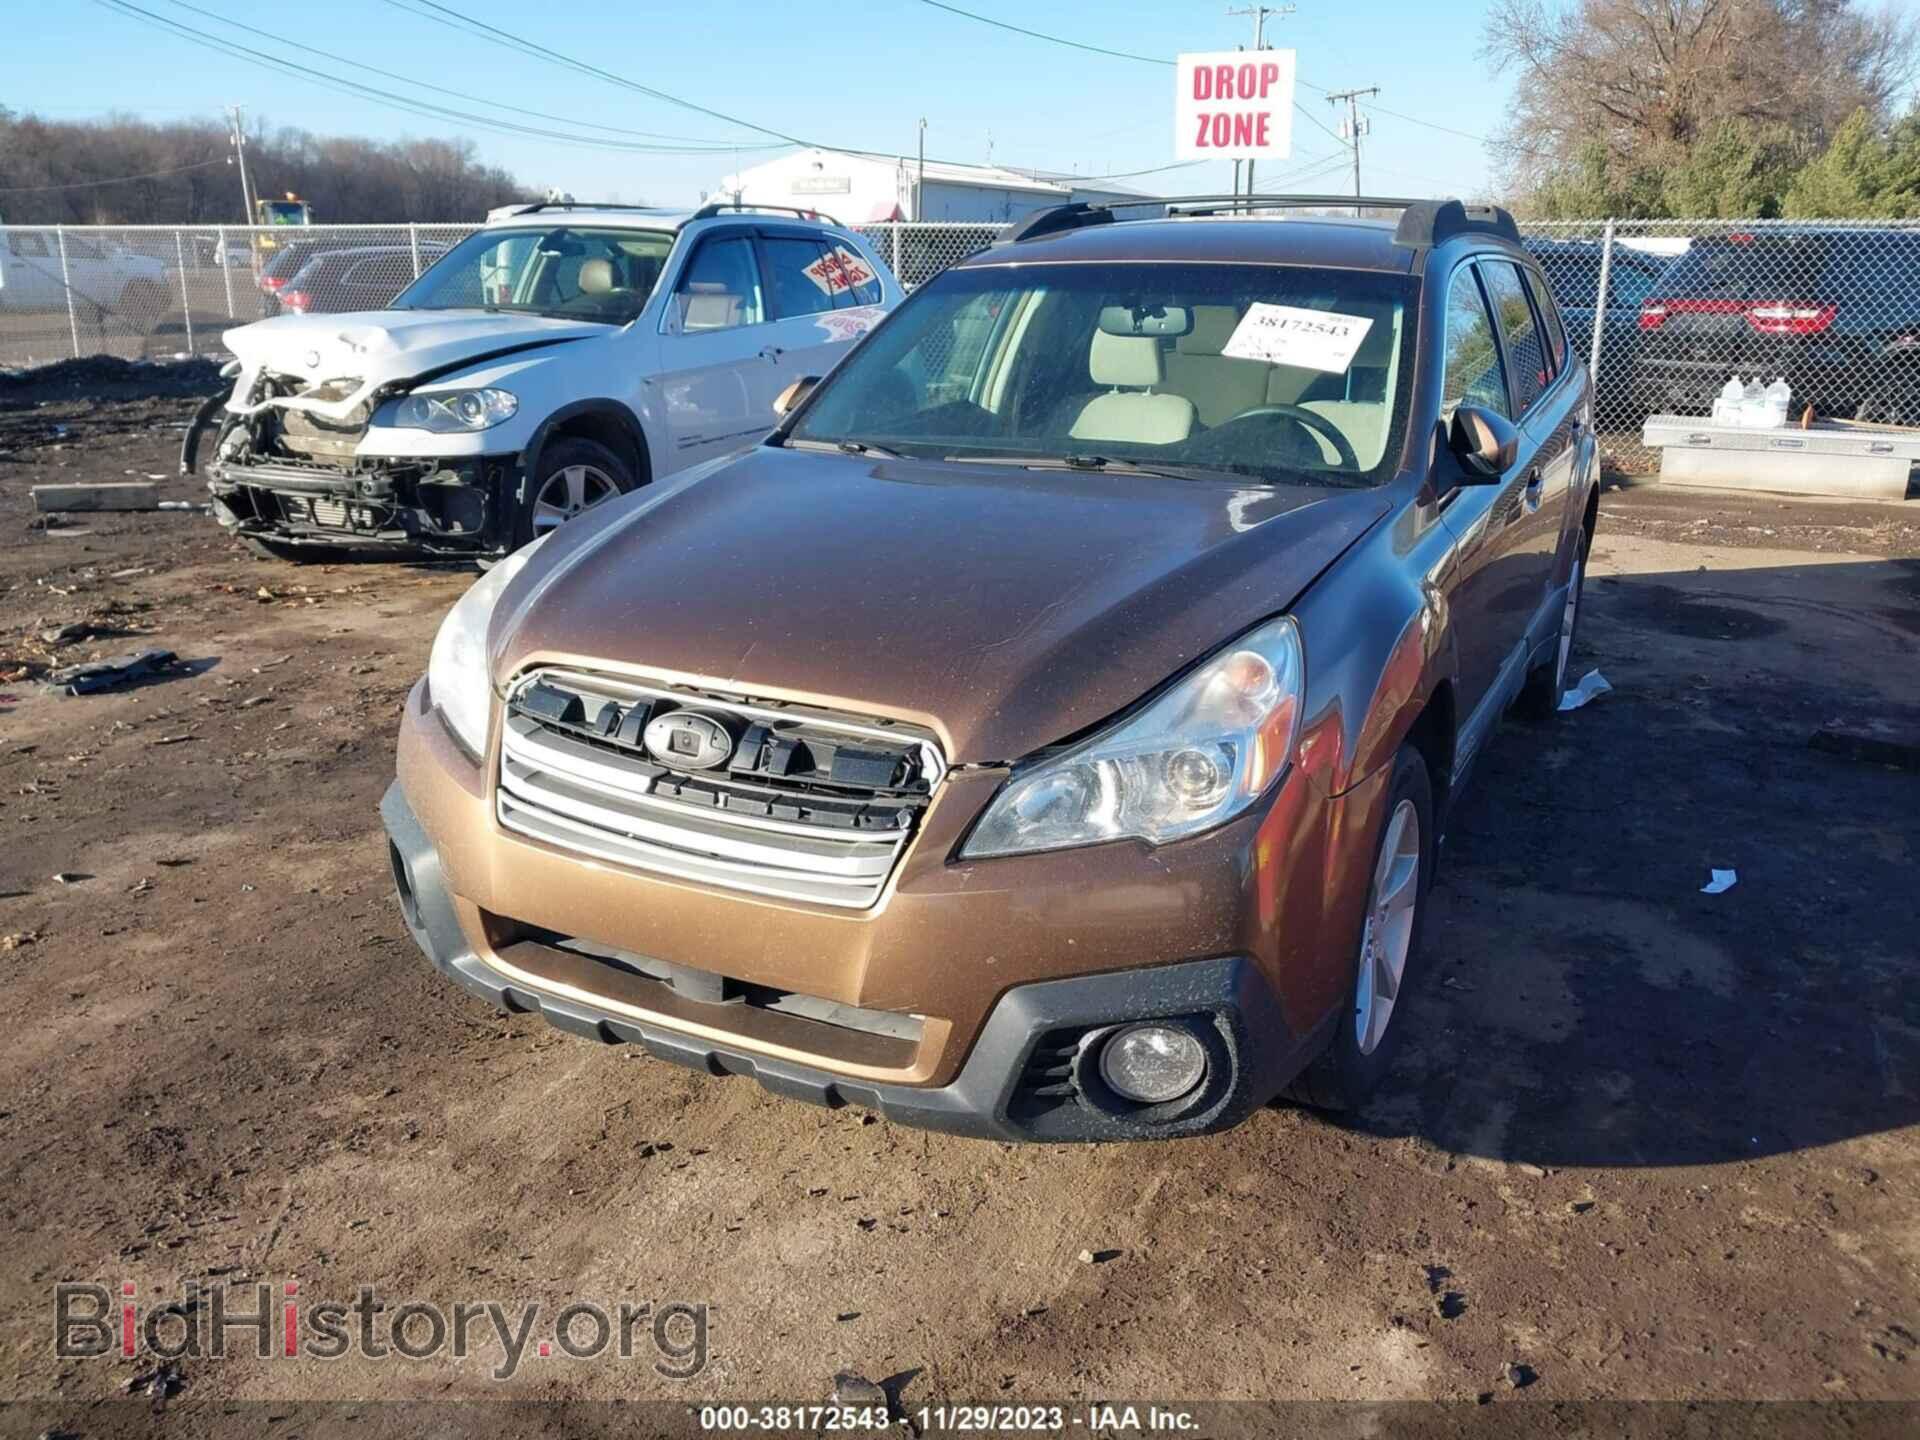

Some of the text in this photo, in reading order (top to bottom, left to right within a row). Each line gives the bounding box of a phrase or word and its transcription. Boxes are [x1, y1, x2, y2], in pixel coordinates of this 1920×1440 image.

[1193, 64, 1279, 100] DROP
[1195, 112, 1271, 148] ZONE
[1253, 316, 1349, 336] 38172543
